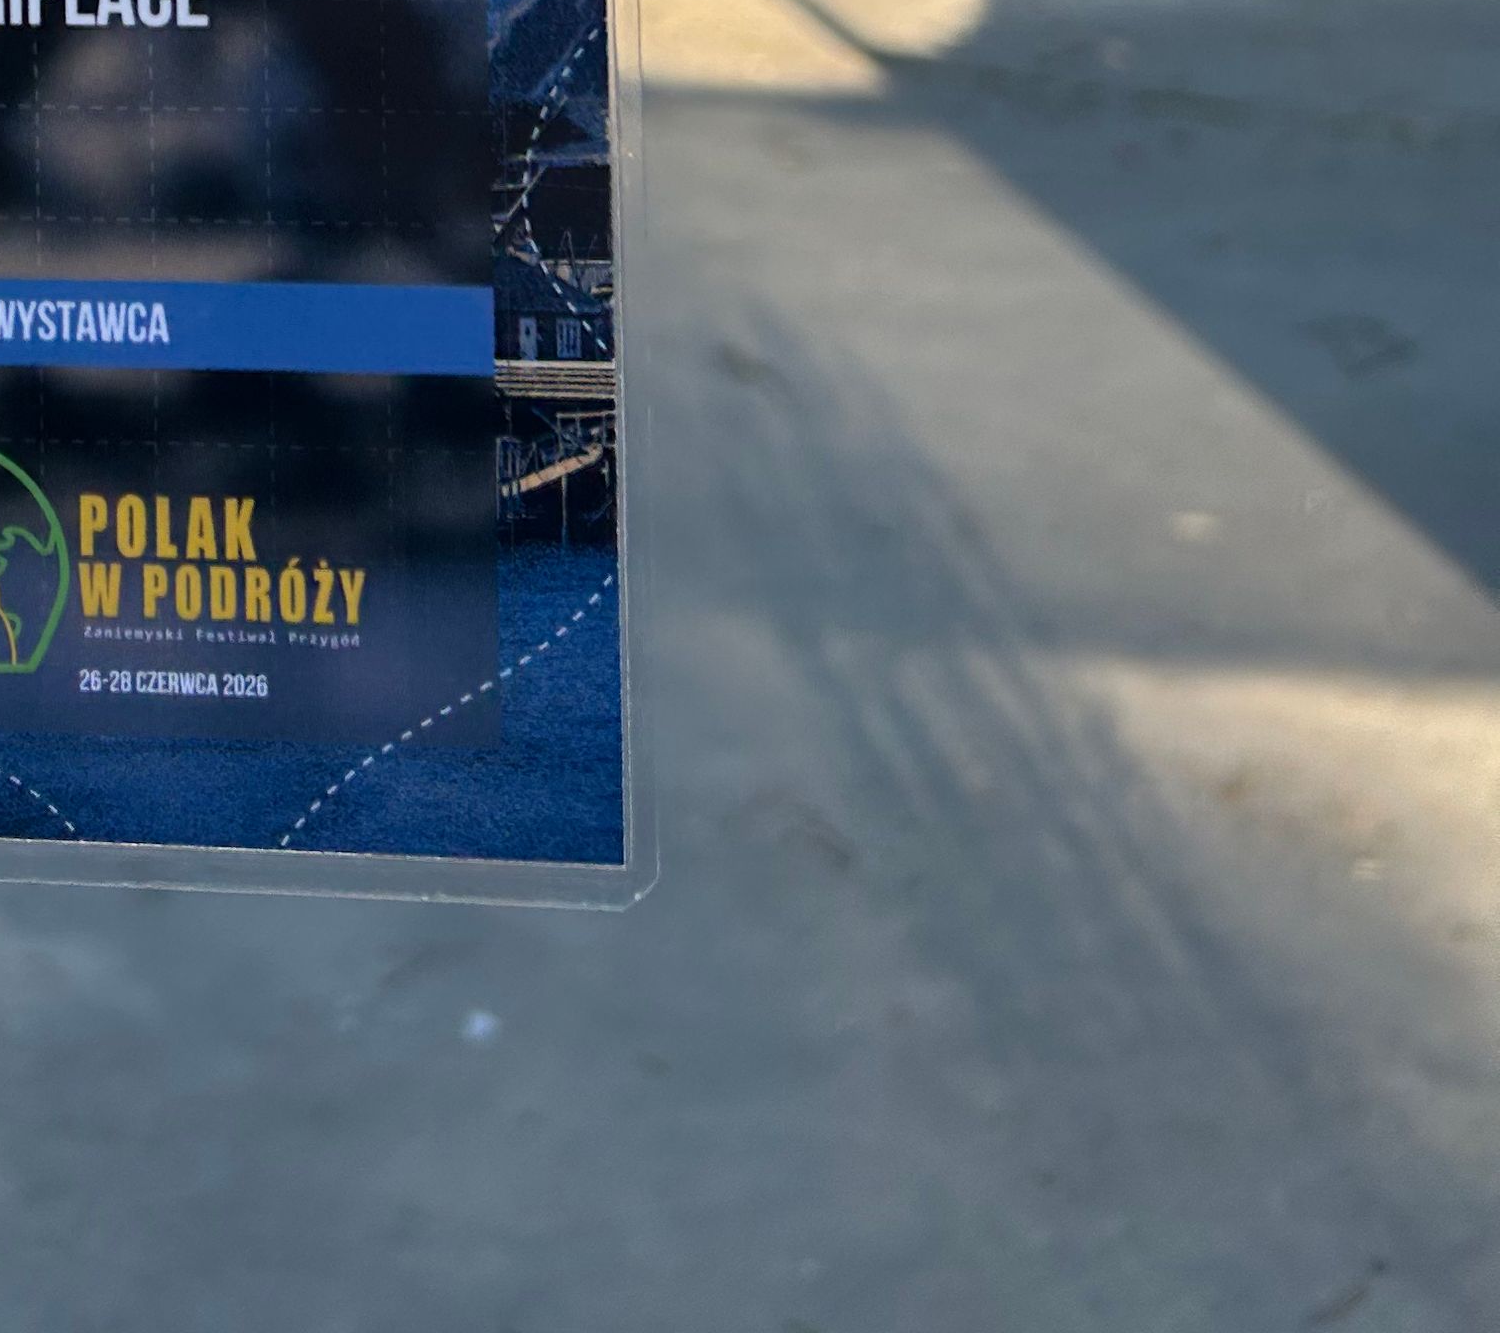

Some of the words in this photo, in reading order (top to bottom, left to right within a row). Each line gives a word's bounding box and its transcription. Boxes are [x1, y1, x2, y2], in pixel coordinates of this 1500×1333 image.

[78, 493, 257, 562] POLAK
[77, 562, 122, 618] W
[142, 555, 366, 625] PODRÓŻY
[83, 625, 184, 642] Zaniemyski
[196, 628, 276, 644] Festiwal
[288, 631, 360, 650] Przygód
[79, 668, 133, 693] 26-28
[135, 670, 219, 696] CZERWCA
[222, 673, 269, 697] 2026
